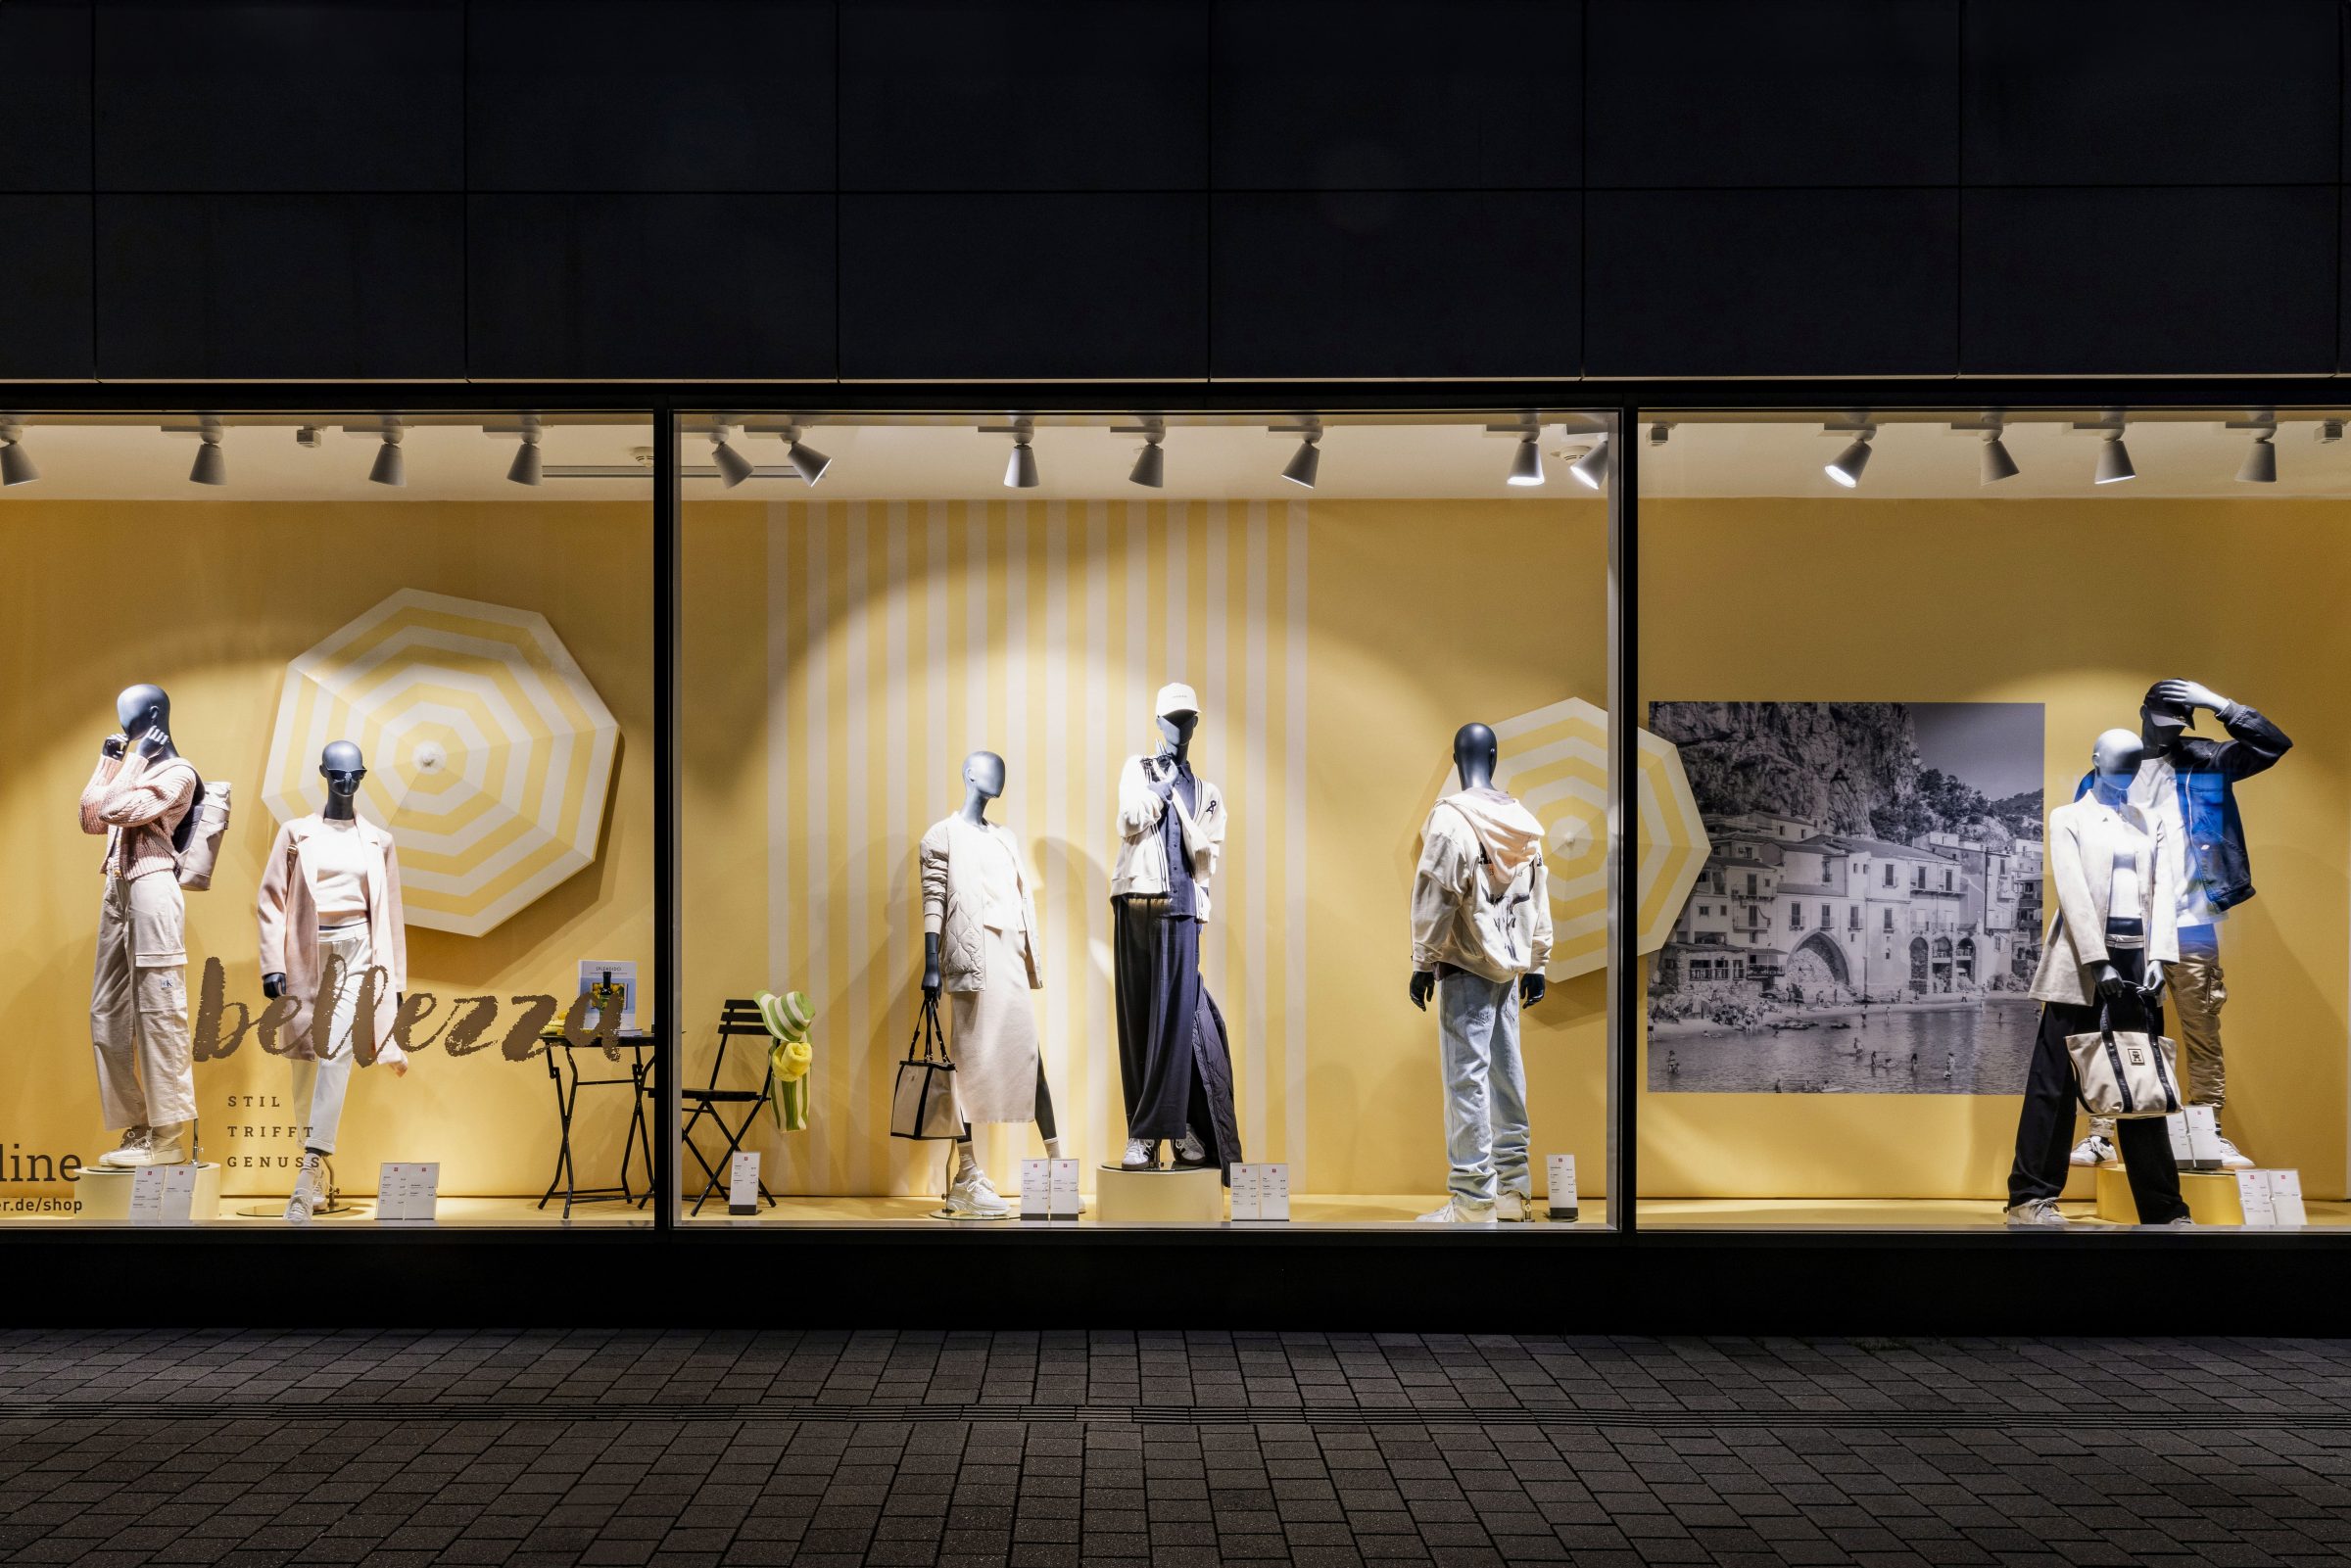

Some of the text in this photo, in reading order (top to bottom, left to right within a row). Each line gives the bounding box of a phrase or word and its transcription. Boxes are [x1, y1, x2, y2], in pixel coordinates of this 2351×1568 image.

[193, 953, 622, 1068] bellezza
[227, 1096, 280, 1108] STIL
[227, 1125, 313, 1137] TRIFFT
[227, 1156, 319, 1168] GENUSS
[0, 1197, 82, 1213] r.de/shop
